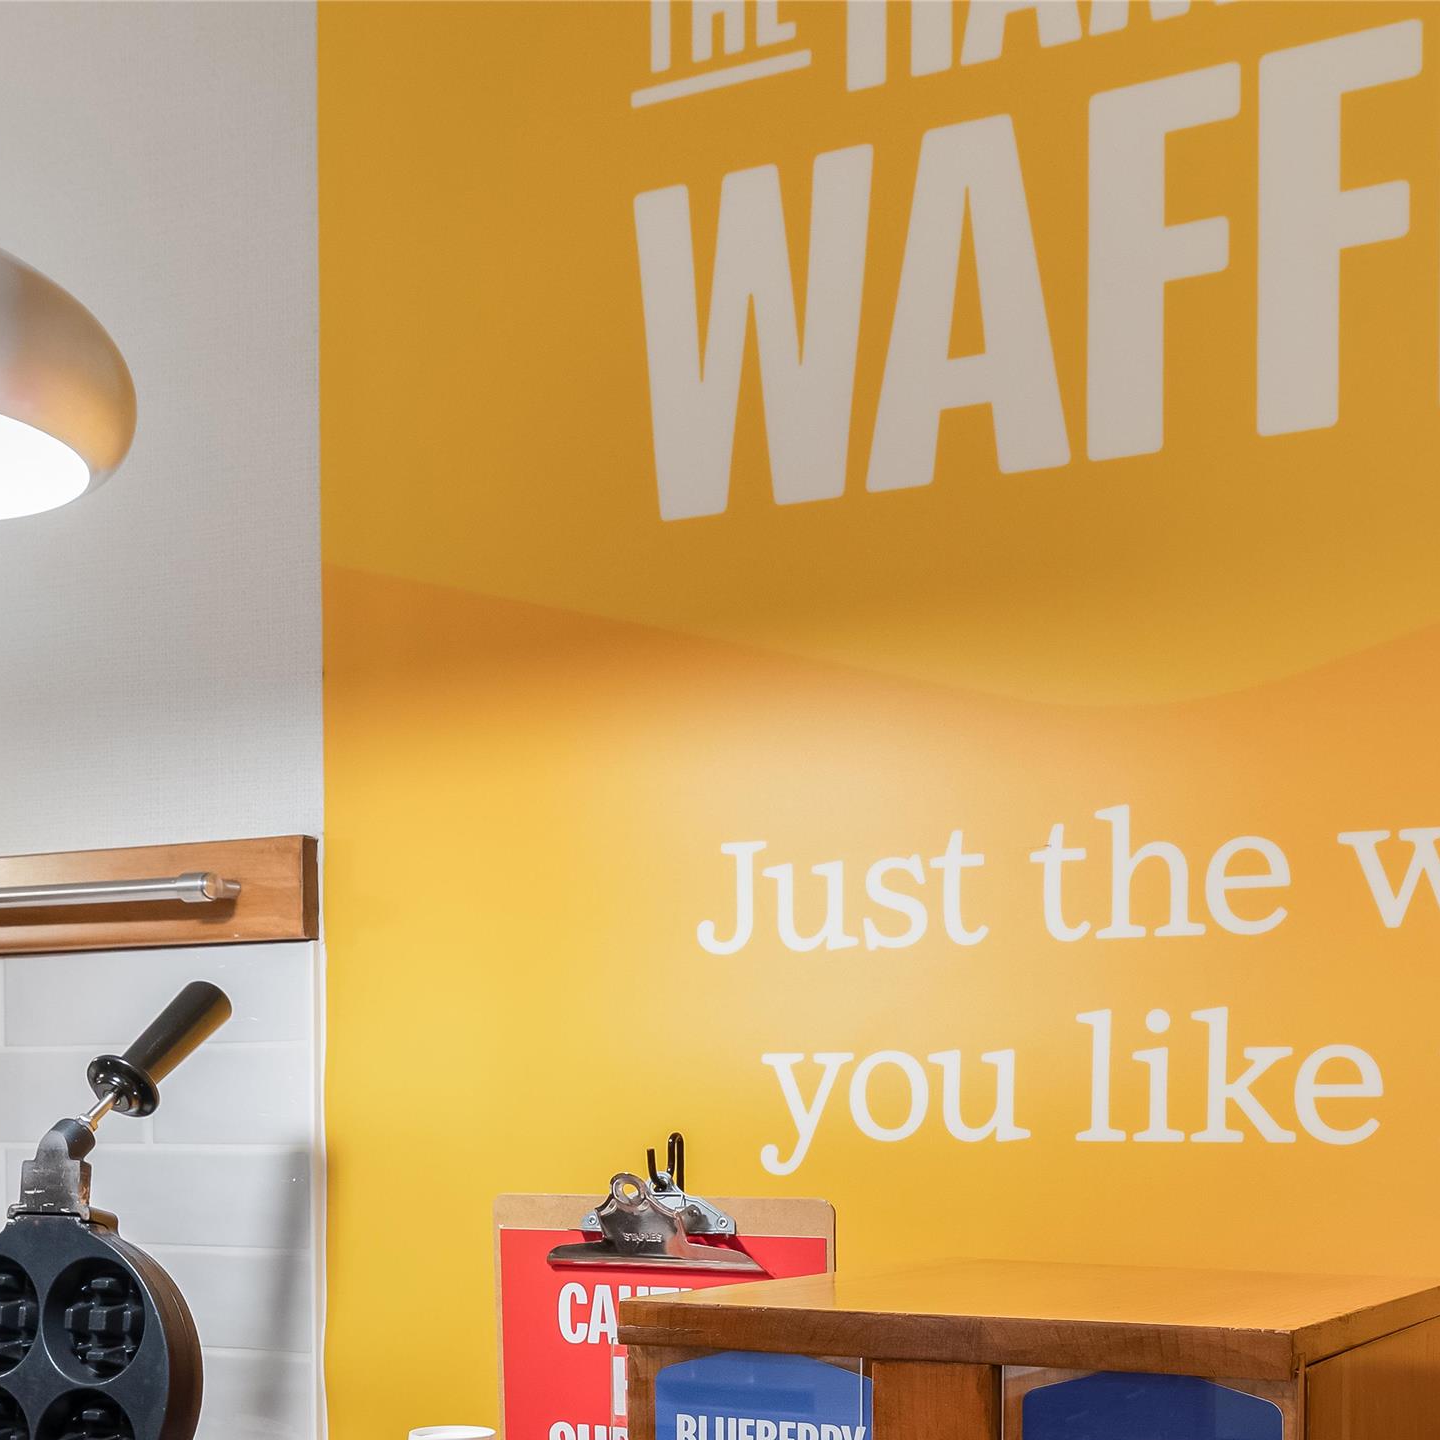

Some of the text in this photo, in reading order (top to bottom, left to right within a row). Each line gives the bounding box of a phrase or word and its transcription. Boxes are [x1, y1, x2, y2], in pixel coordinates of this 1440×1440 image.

[695, 829, 990, 956] Just
[1029, 803, 1293, 941] the
[760, 1046, 1032, 1177] you
[1074, 1005, 1385, 1146] like
